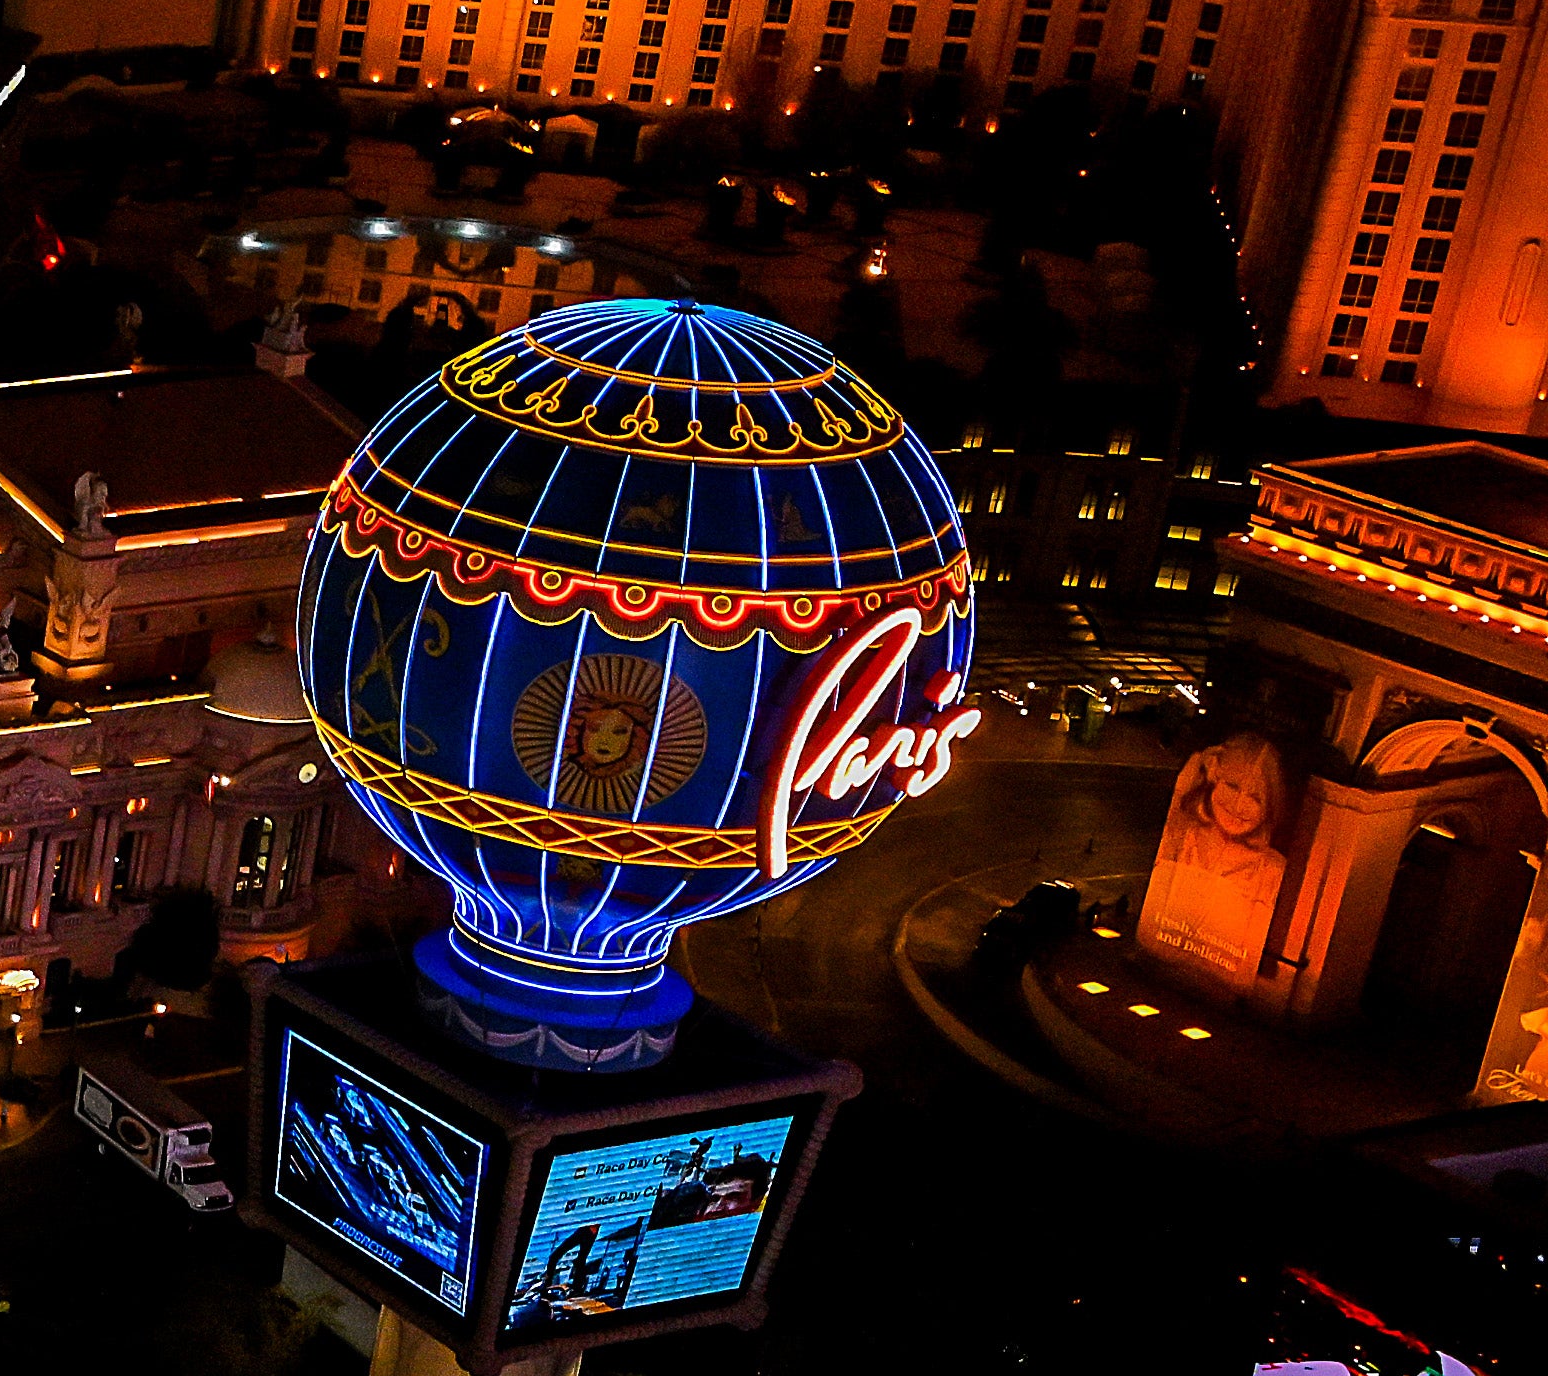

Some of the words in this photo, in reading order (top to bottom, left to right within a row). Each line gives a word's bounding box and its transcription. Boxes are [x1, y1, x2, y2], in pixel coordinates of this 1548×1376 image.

[766, 605, 983, 880] Paris
[595, 1161, 625, 1177] Race
[626, 1155, 655, 1173] Day
[585, 1194, 616, 1210] Race
[617, 1188, 644, 1206] Day
[332, 1216, 404, 1268] PROGRESSIVE
